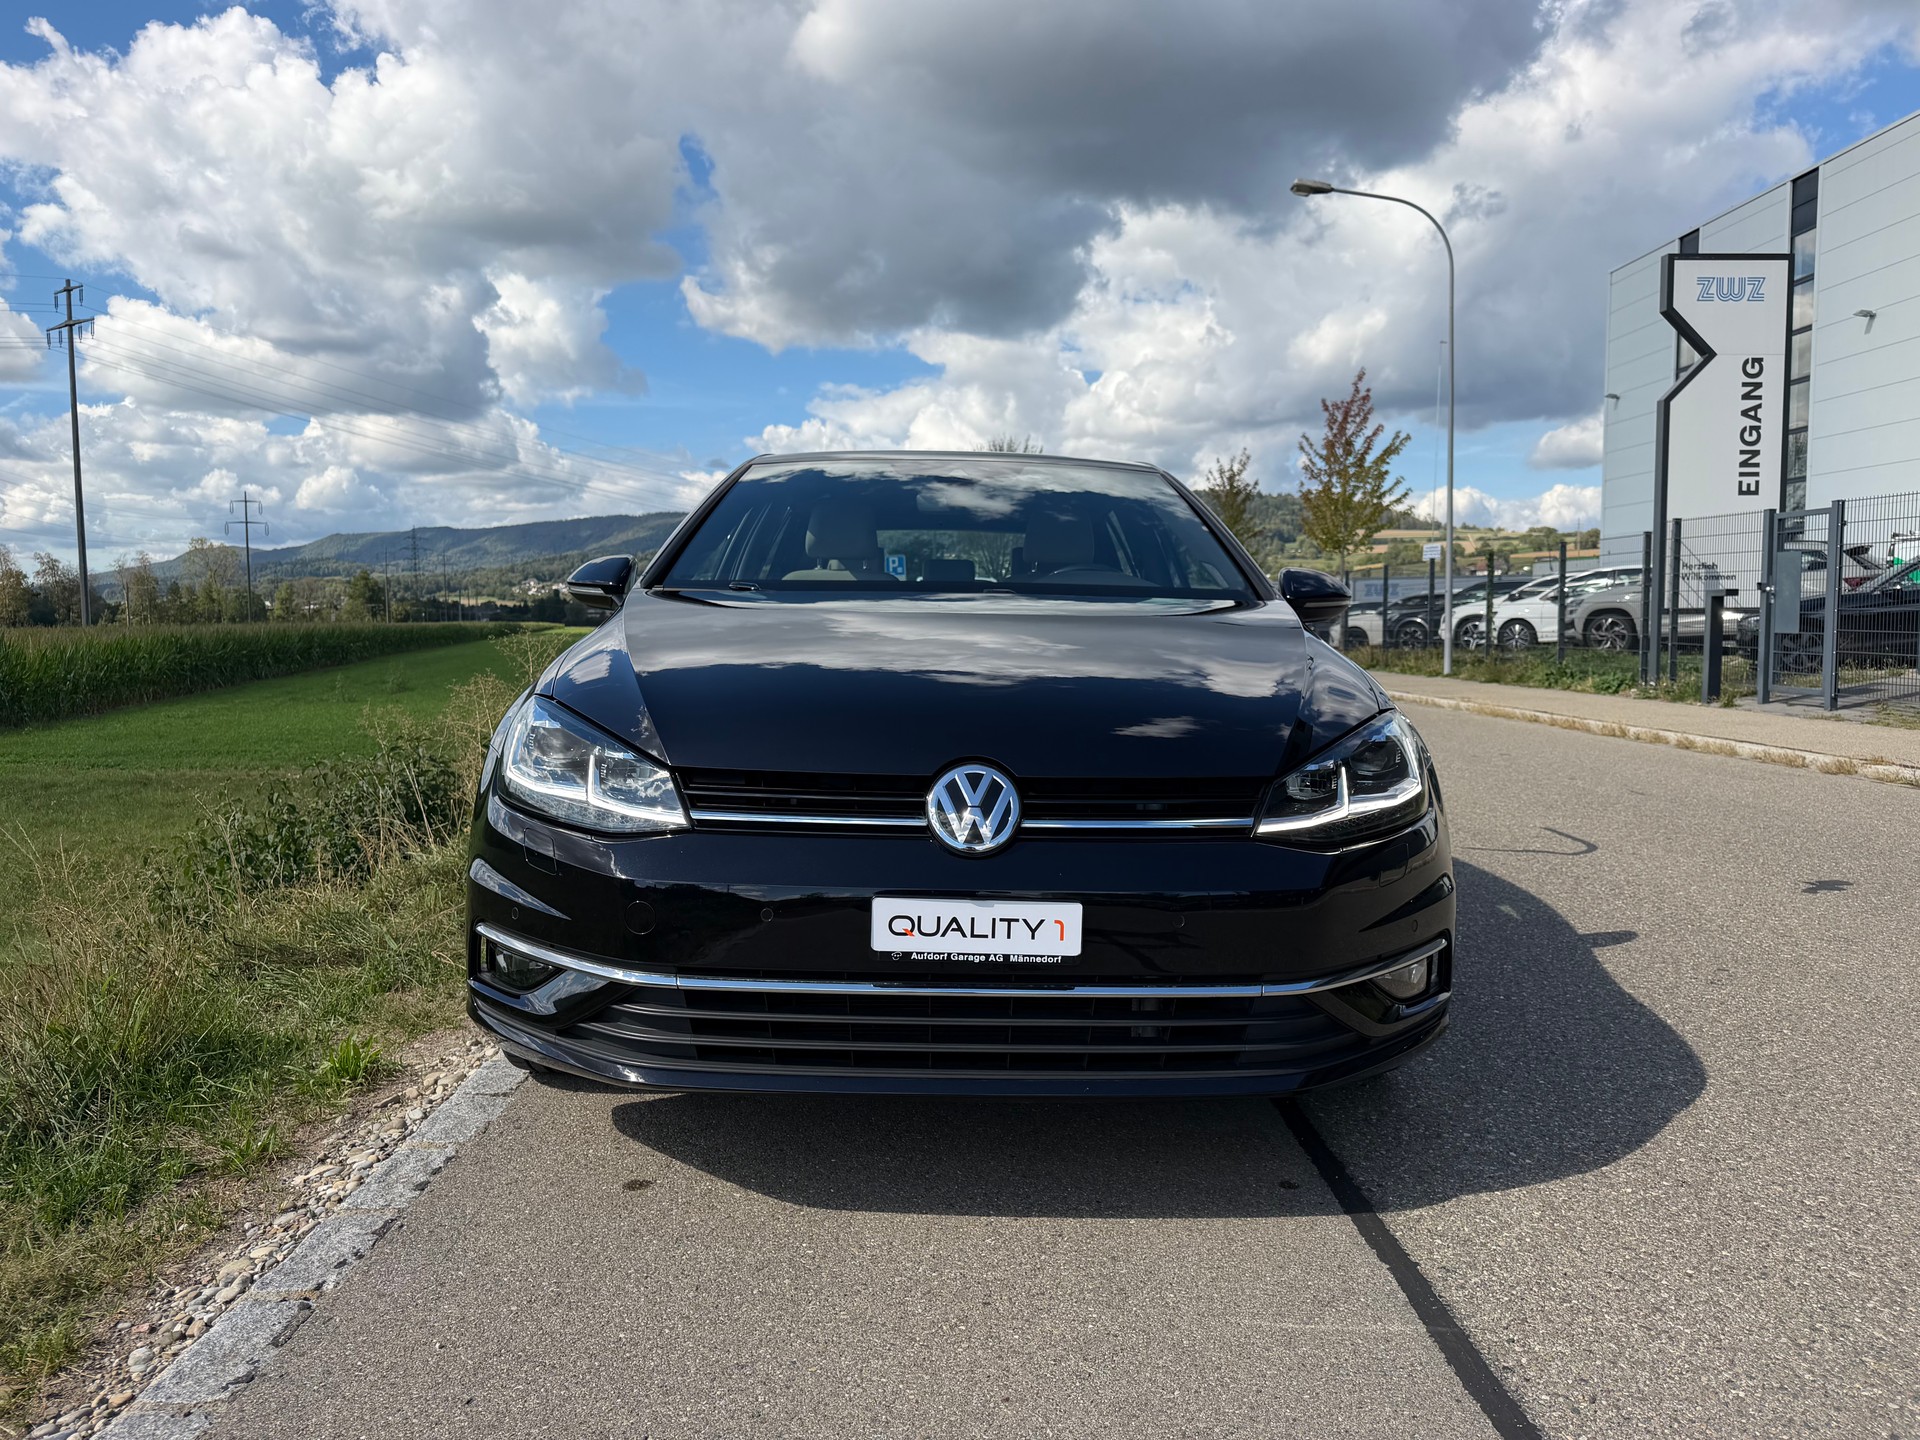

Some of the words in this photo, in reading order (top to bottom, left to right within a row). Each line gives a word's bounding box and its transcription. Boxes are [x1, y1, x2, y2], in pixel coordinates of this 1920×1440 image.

[1696, 276, 1766, 302] ZWZ
[1738, 357, 1764, 496] EINGANG
[888, 915, 1046, 940] QUALITY
[1054, 919, 1065, 941] 1
[911, 952, 948, 960] Aufdorf
[950, 953, 986, 963] Garage
[988, 954, 1004, 962] AG
[1009, 954, 1062, 963] Männedorf
